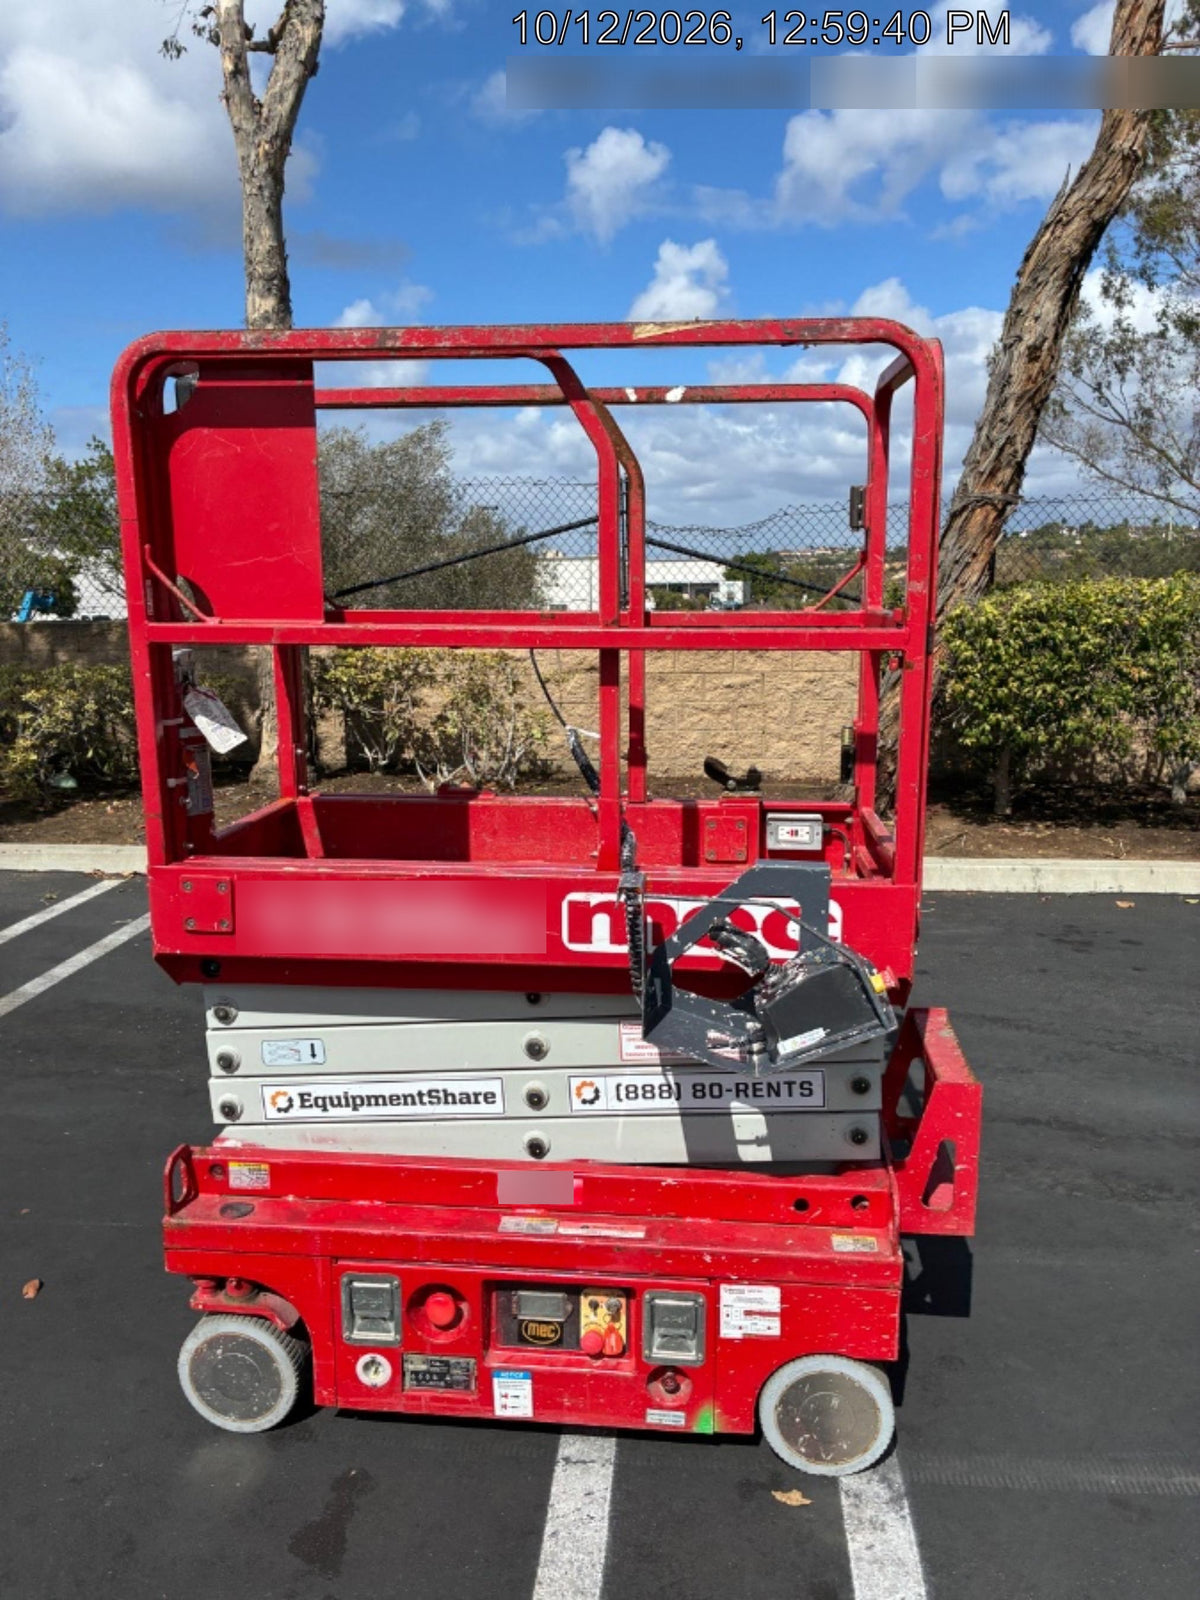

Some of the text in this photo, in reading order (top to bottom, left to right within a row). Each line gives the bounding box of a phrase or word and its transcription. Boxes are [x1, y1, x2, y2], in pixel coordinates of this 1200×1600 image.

[298, 1088, 497, 1112] EquipmentShare
[616, 1079, 815, 1102] (888) 80-RENTS
